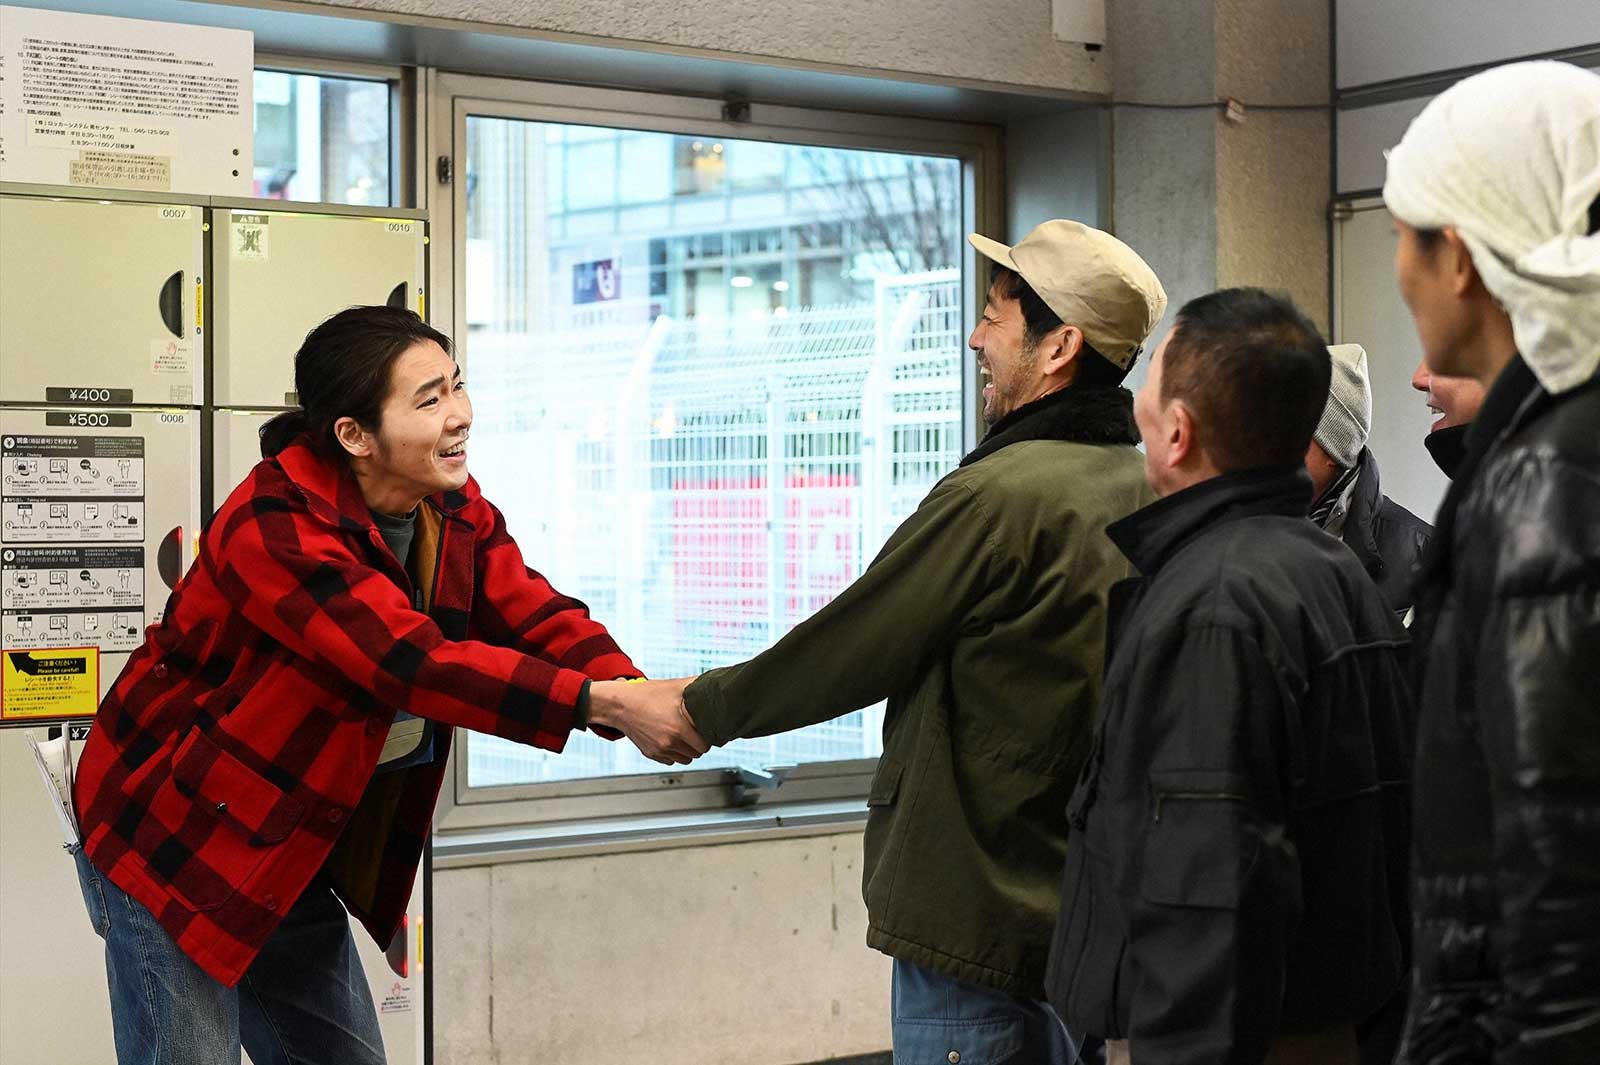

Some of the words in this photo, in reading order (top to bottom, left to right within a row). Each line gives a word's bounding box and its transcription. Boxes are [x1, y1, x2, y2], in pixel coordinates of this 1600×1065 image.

[162, 209, 186, 218] 0007
[388, 223, 410, 232] 0010
[70, 388, 110, 402] ¥400
[69, 413, 109, 426] ¥500
[160, 414, 184, 423] 0008
